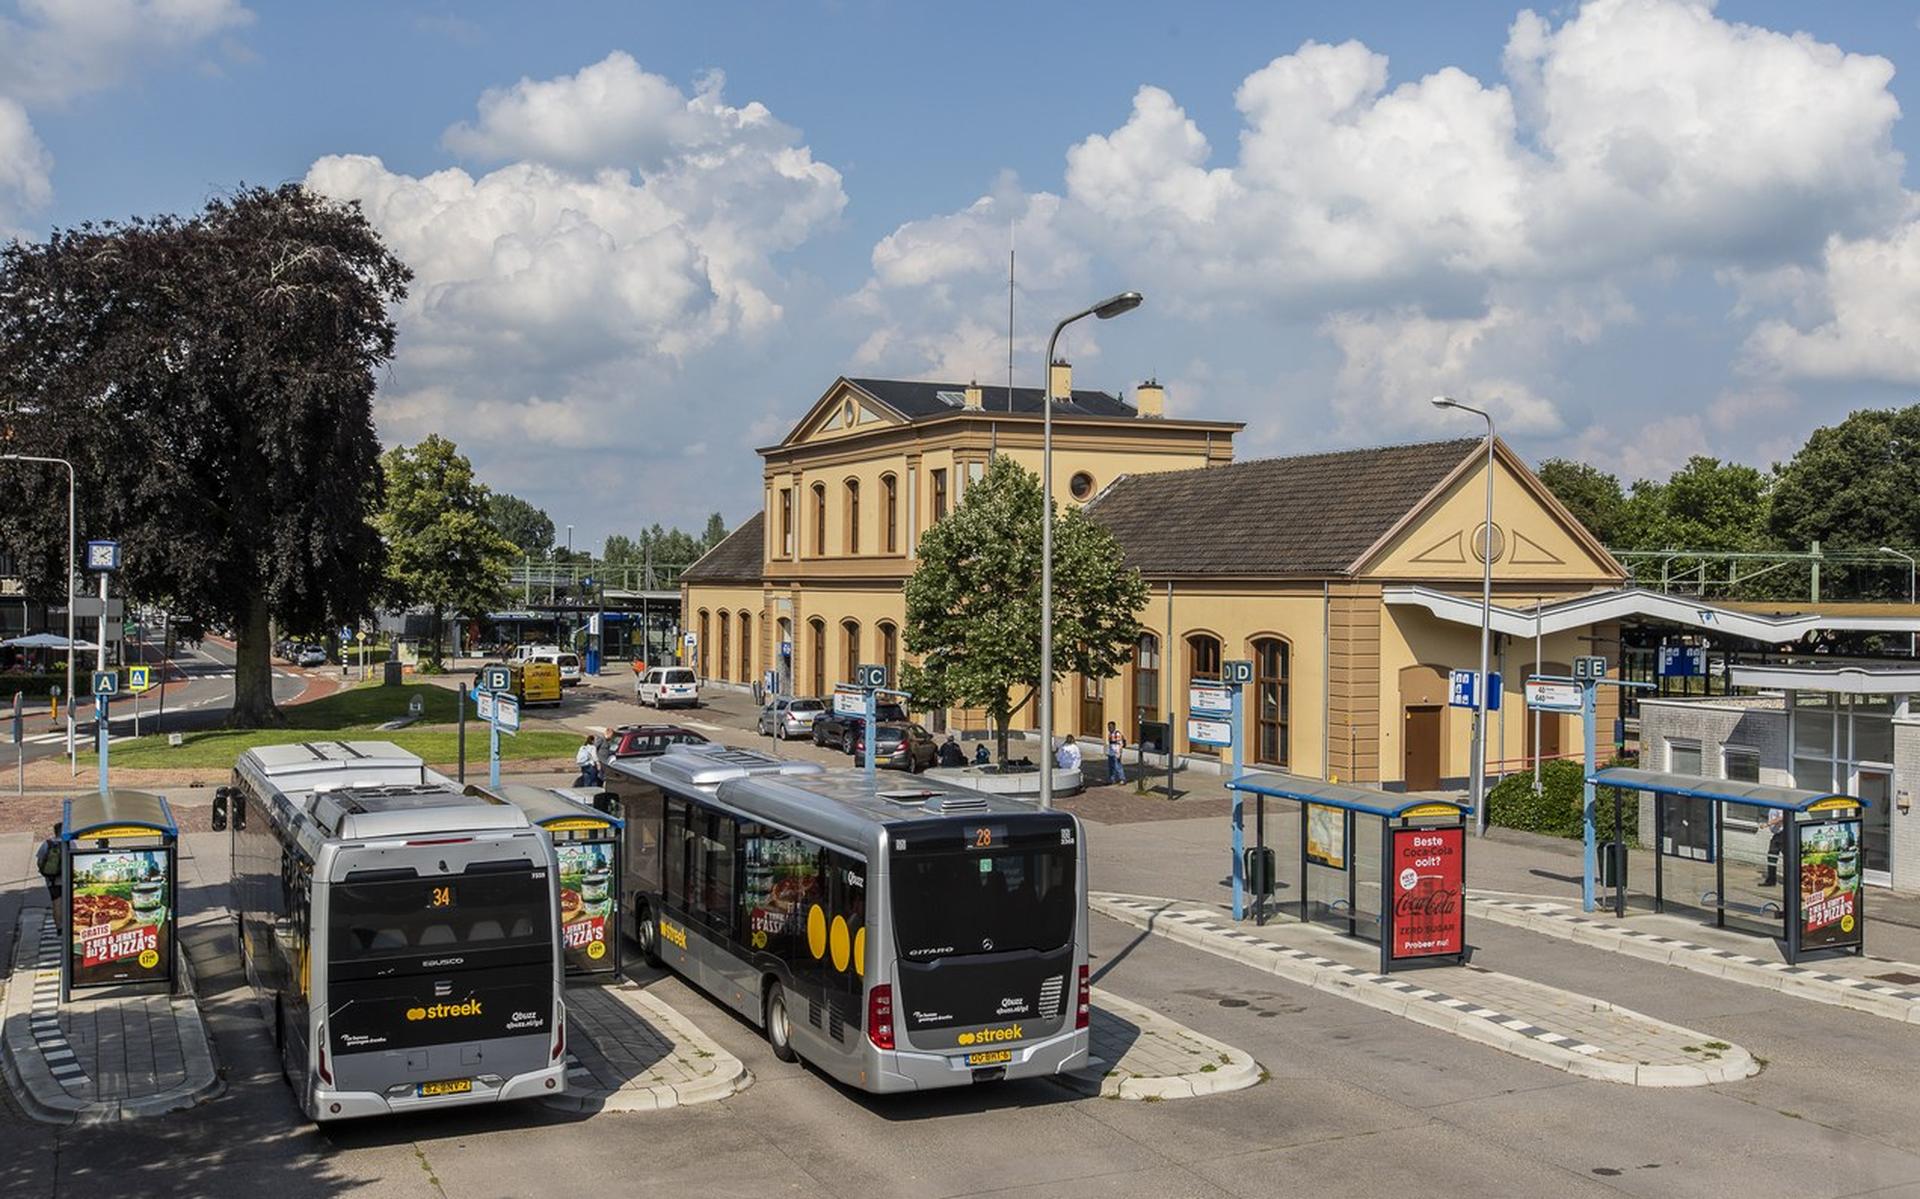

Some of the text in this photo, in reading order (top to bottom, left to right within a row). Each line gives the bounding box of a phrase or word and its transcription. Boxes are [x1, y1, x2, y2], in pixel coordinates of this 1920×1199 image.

[1237, 665, 1249, 680] D
[1577, 660, 1586, 676] E
[1593, 660, 1603, 676] E
[98, 675, 112, 691] A
[492, 672, 505, 687] B
[870, 669, 882, 684] C
[976, 828, 991, 847] 28
[1413, 836, 1443, 847] Beste
[1415, 856, 1441, 868] ooit?
[433, 886, 451, 906] 34
[1396, 888, 1458, 917] Coca-Cola
[1823, 900, 1853, 923] PIZZA'S
[81, 926, 109, 940] GRATIS
[98, 946, 108, 961] 2
[110, 934, 157, 958] PIZZA'S
[909, 946, 954, 956] CITARO
[1404, 941, 1435, 950] Probeer
[427, 999, 482, 1019] streek
[511, 1012, 537, 1021] Qbuzz
[975, 1024, 1022, 1043] streek
